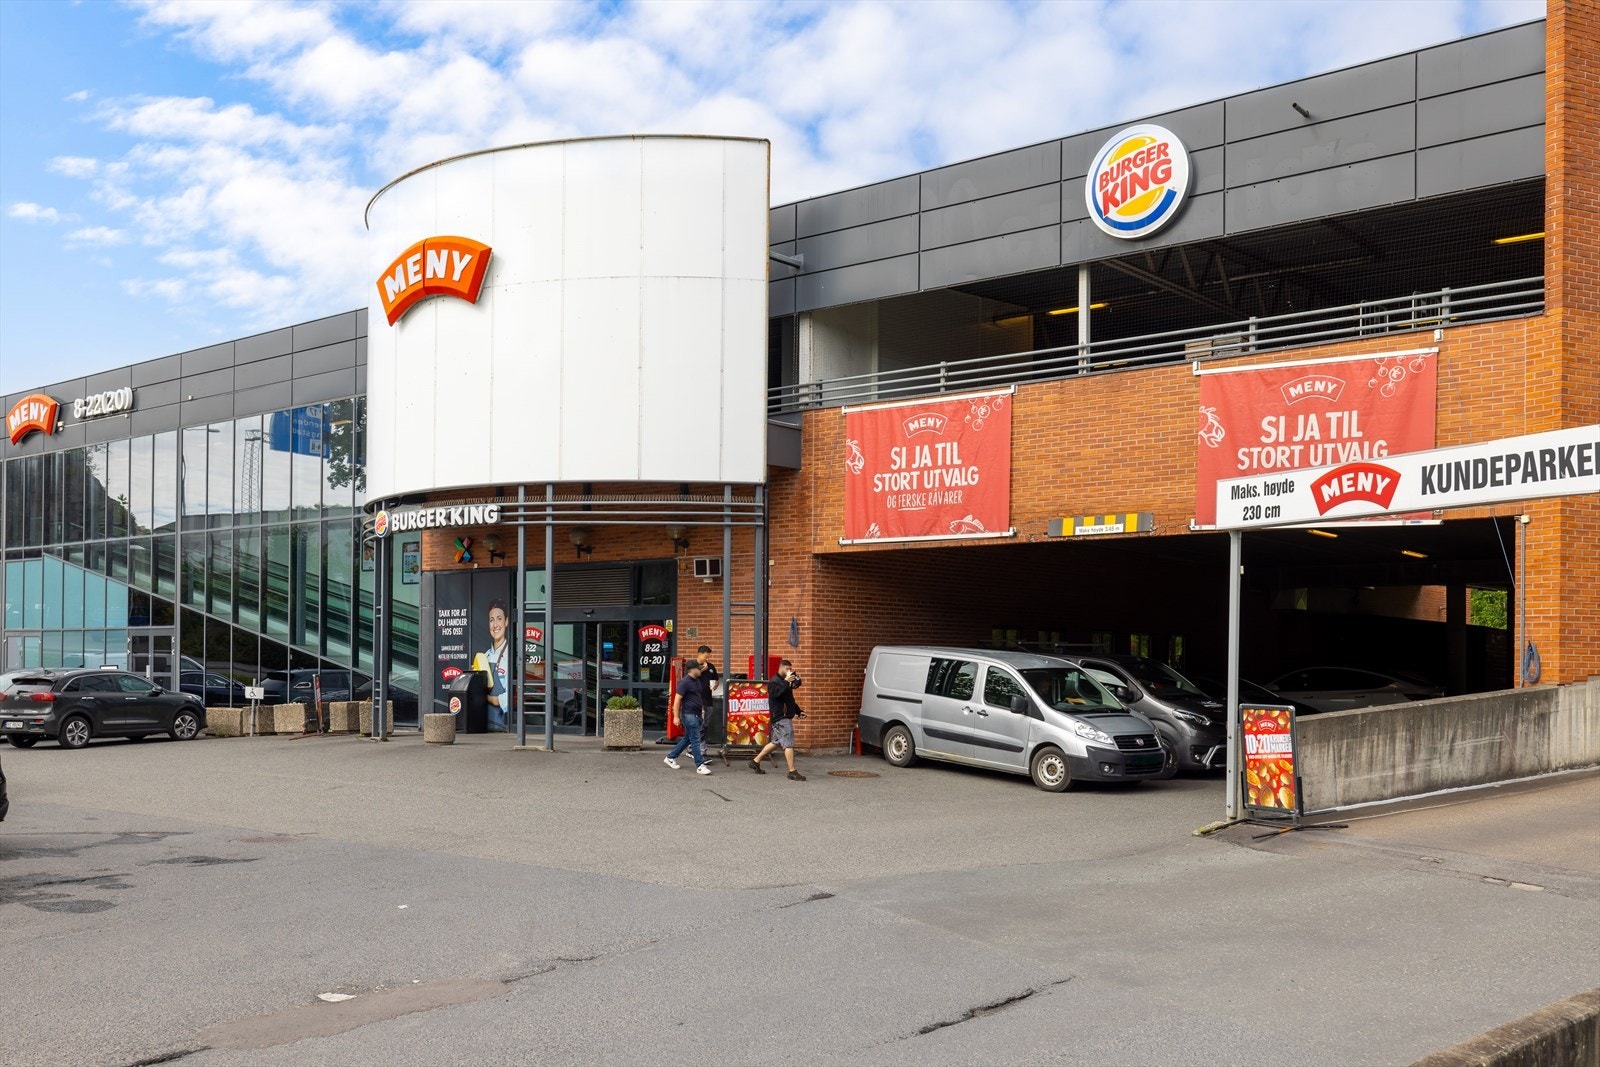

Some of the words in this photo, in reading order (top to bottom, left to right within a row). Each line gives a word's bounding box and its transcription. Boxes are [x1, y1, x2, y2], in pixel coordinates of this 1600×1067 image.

[1099, 142, 1169, 192] BURGER
[1102, 158, 1172, 217] KING
[383, 249, 473, 304] MENY
[1288, 380, 1338, 398] MENY
[9, 402, 49, 432] MENY
[908, 417, 943, 432] MENY
[1260, 415, 1286, 444] SI
[1293, 413, 1321, 442] JA
[1326, 410, 1363, 439] TIL
[890, 446, 907, 470] SI
[912, 445, 932, 468] JA
[935, 442, 962, 466] TIL
[1237, 445, 1304, 470] STORT
[873, 471, 920, 493] STORT
[924, 466, 979, 489] UTVALG
[1231, 483, 1261, 500] Maks.
[1263, 478, 1295, 498] høyde
[1320, 471, 1392, 503] MENY
[887, 495, 897, 508] OG
[898, 493, 927, 507] FERSKE
[928, 489, 963, 505] RÅVARER
[391, 507, 447, 532] BURGER
[450, 504, 500, 525] KING
[1242, 505, 1262, 521] 230
[1265, 505, 1281, 519] cm
[438, 609, 450, 617] TAKK
[451, 609, 460, 617] FOR
[461, 608, 467, 616] AT
[438, 619, 446, 627] DU
[446, 618, 467, 626] HANDLER
[442, 628, 452, 636] HOS
[526, 629, 541, 639] ENY
[641, 627, 665, 638] MENY
